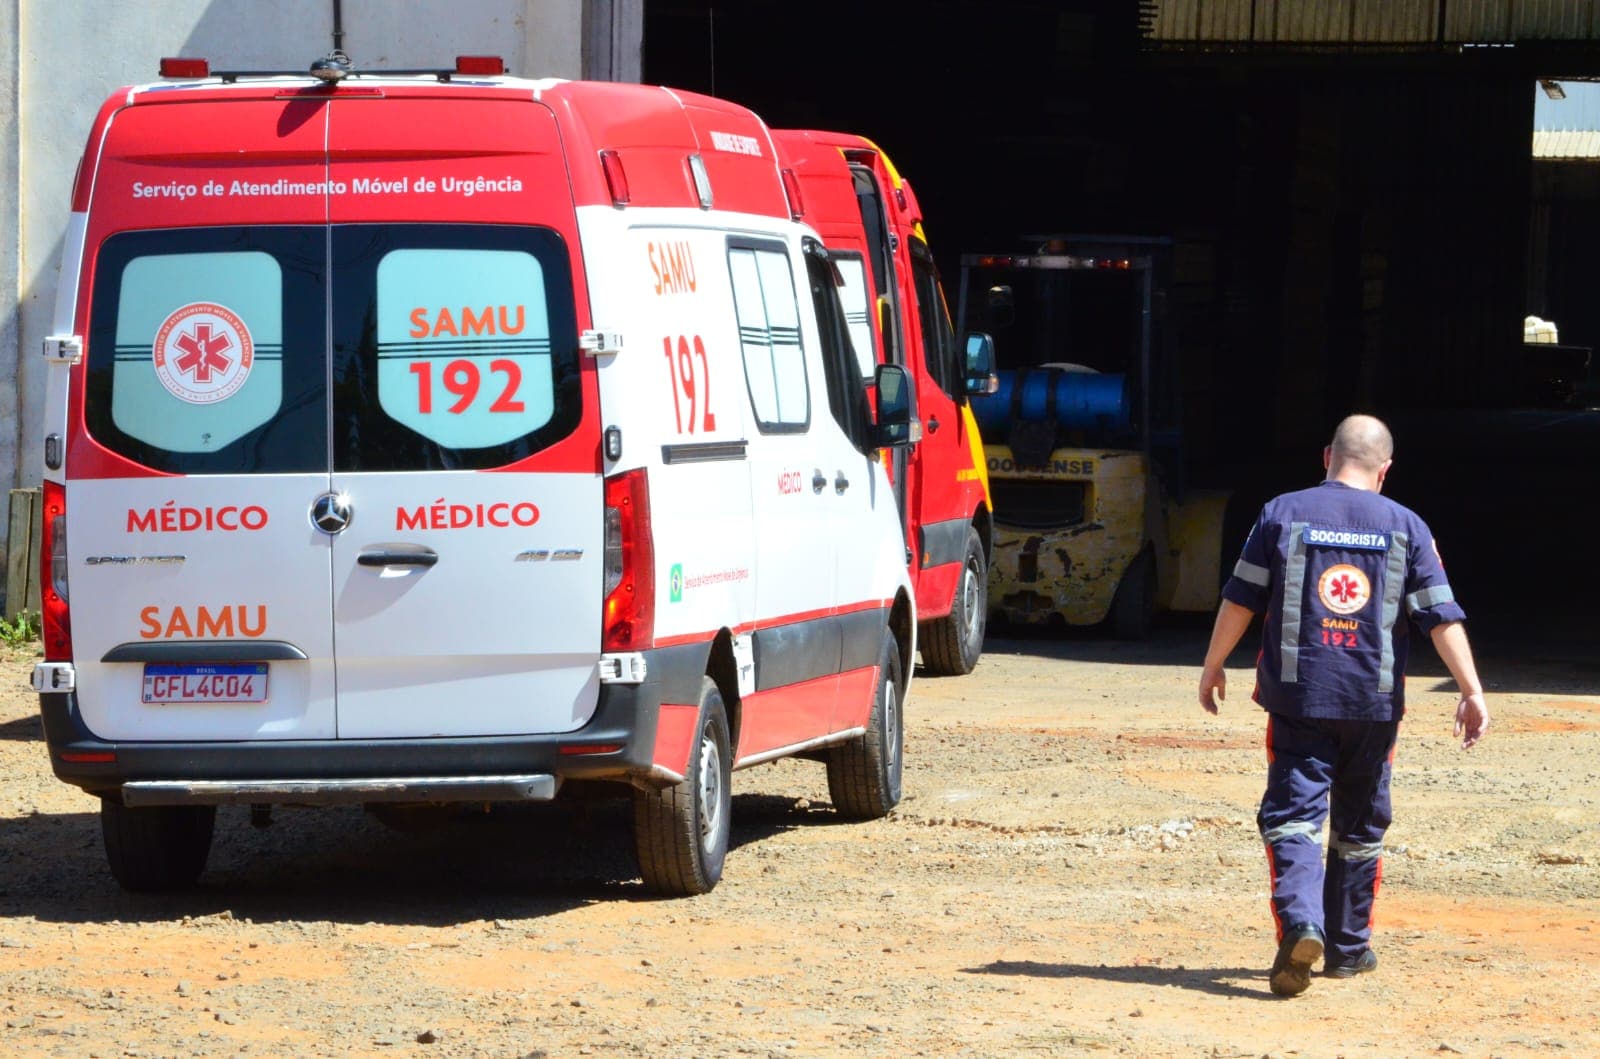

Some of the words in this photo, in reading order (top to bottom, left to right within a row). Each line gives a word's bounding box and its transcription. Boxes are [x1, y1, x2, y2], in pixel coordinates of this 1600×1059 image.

[133, 181, 197, 200] Serviço
[202, 180, 224, 196] de
[229, 179, 346, 196] Atendimento
[352, 177, 408, 194] Móvel
[413, 176, 436, 193] de
[441, 176, 523, 197] Urgência
[648, 240, 697, 296] SAMU
[409, 305, 525, 339] SAMU
[408, 359, 525, 415] 192
[663, 334, 716, 435] 192
[126, 500, 268, 533] MÉDICO
[395, 498, 540, 531] MÉDICO
[1310, 529, 1386, 547] SOCORRISTA
[140, 605, 267, 639] SAMU
[1321, 617, 1358, 630] SAMU
[1322, 631, 1358, 647] 192
[153, 675, 254, 698] CFL4C04
